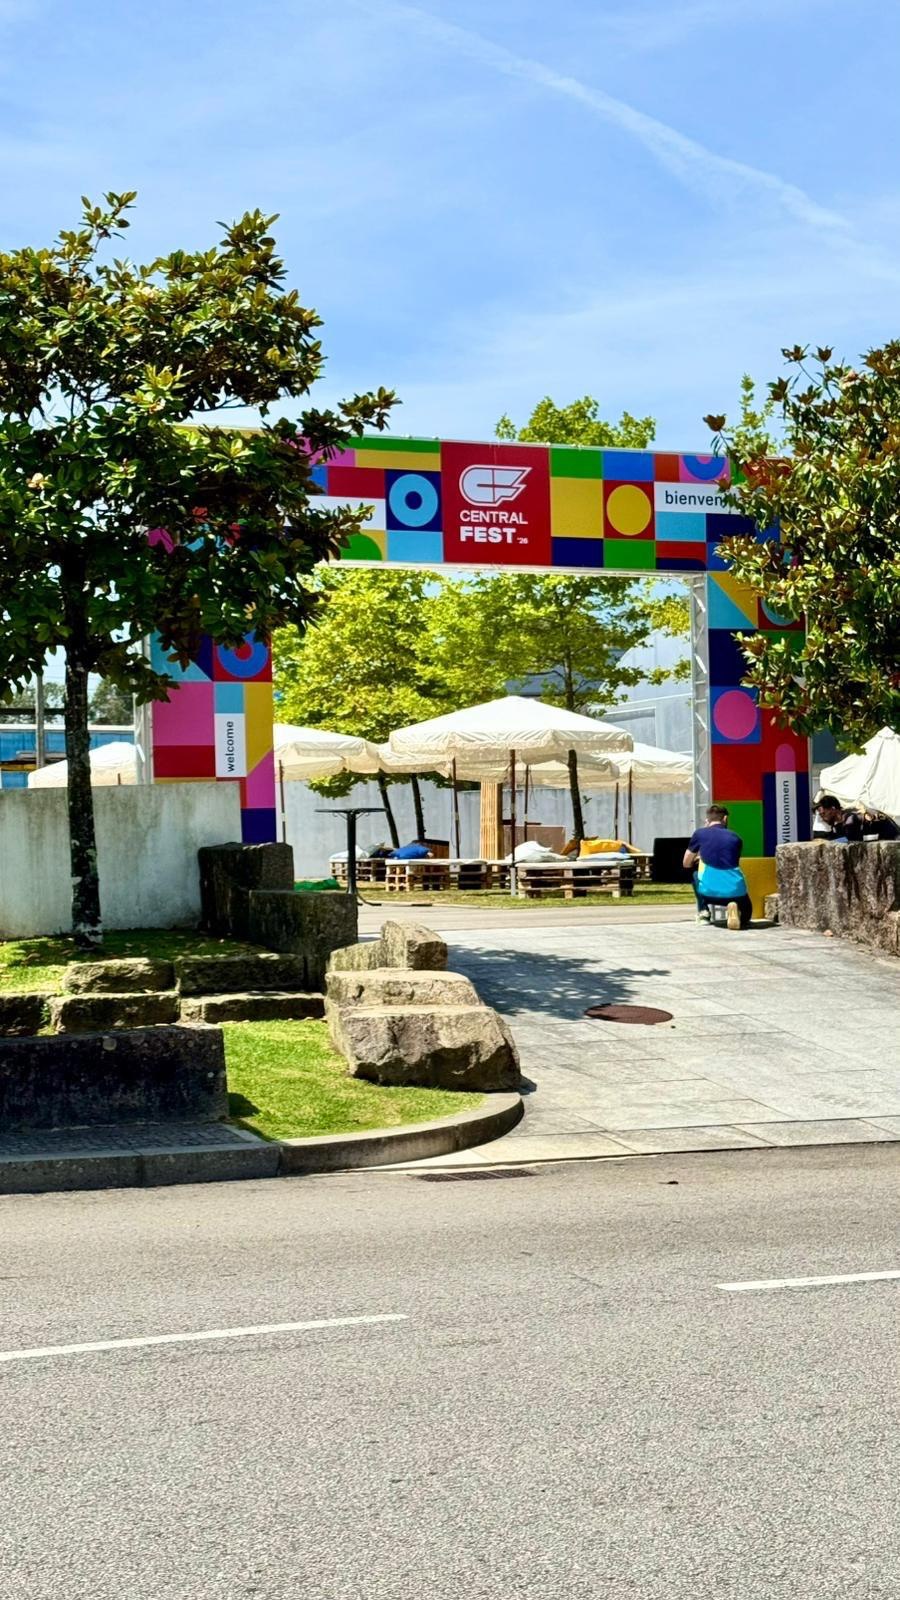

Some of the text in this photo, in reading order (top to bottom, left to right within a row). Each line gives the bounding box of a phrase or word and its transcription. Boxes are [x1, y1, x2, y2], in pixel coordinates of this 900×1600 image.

[665, 490, 740, 507] bienven
[459, 510, 528, 525] CENTRAL
[459, 526, 516, 544] FEST
[224, 721, 235, 772] welcome
